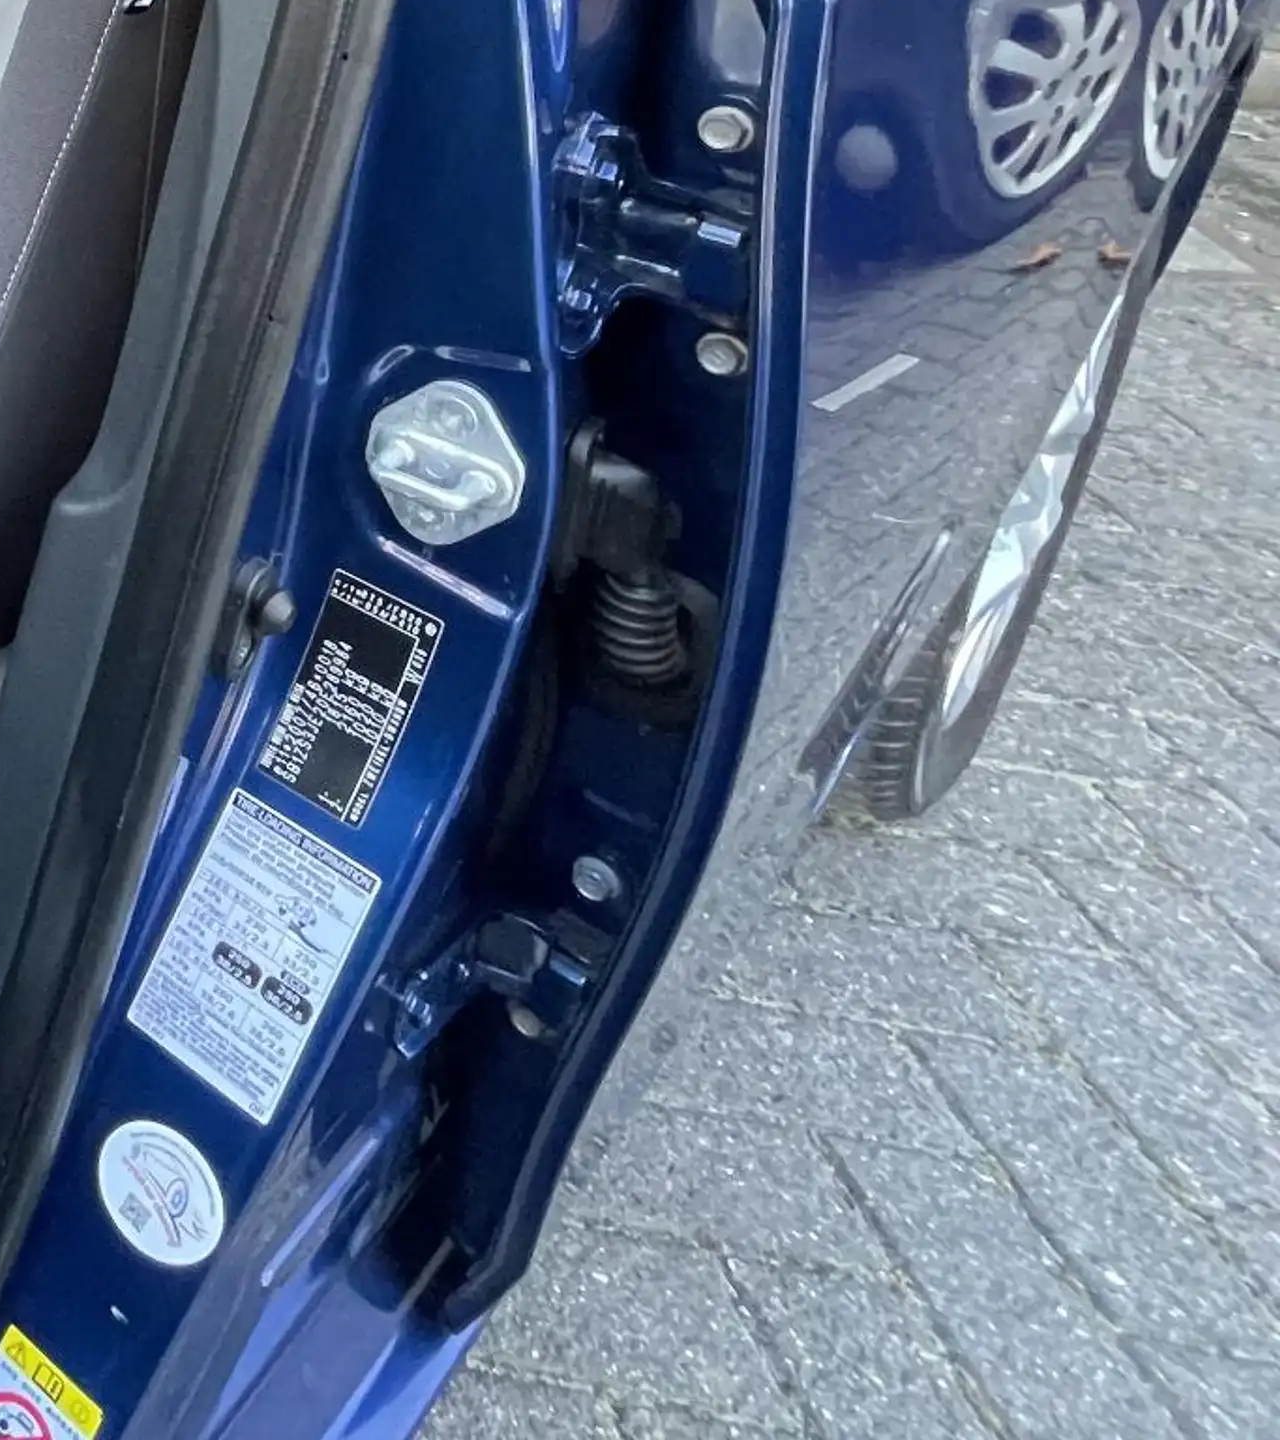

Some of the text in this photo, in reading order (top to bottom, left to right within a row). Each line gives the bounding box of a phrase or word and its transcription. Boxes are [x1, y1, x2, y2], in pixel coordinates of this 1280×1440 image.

[349, 701, 375, 740] 1020
[361, 710, 386, 747] 1010
[299, 836, 374, 892] INFORMATION
